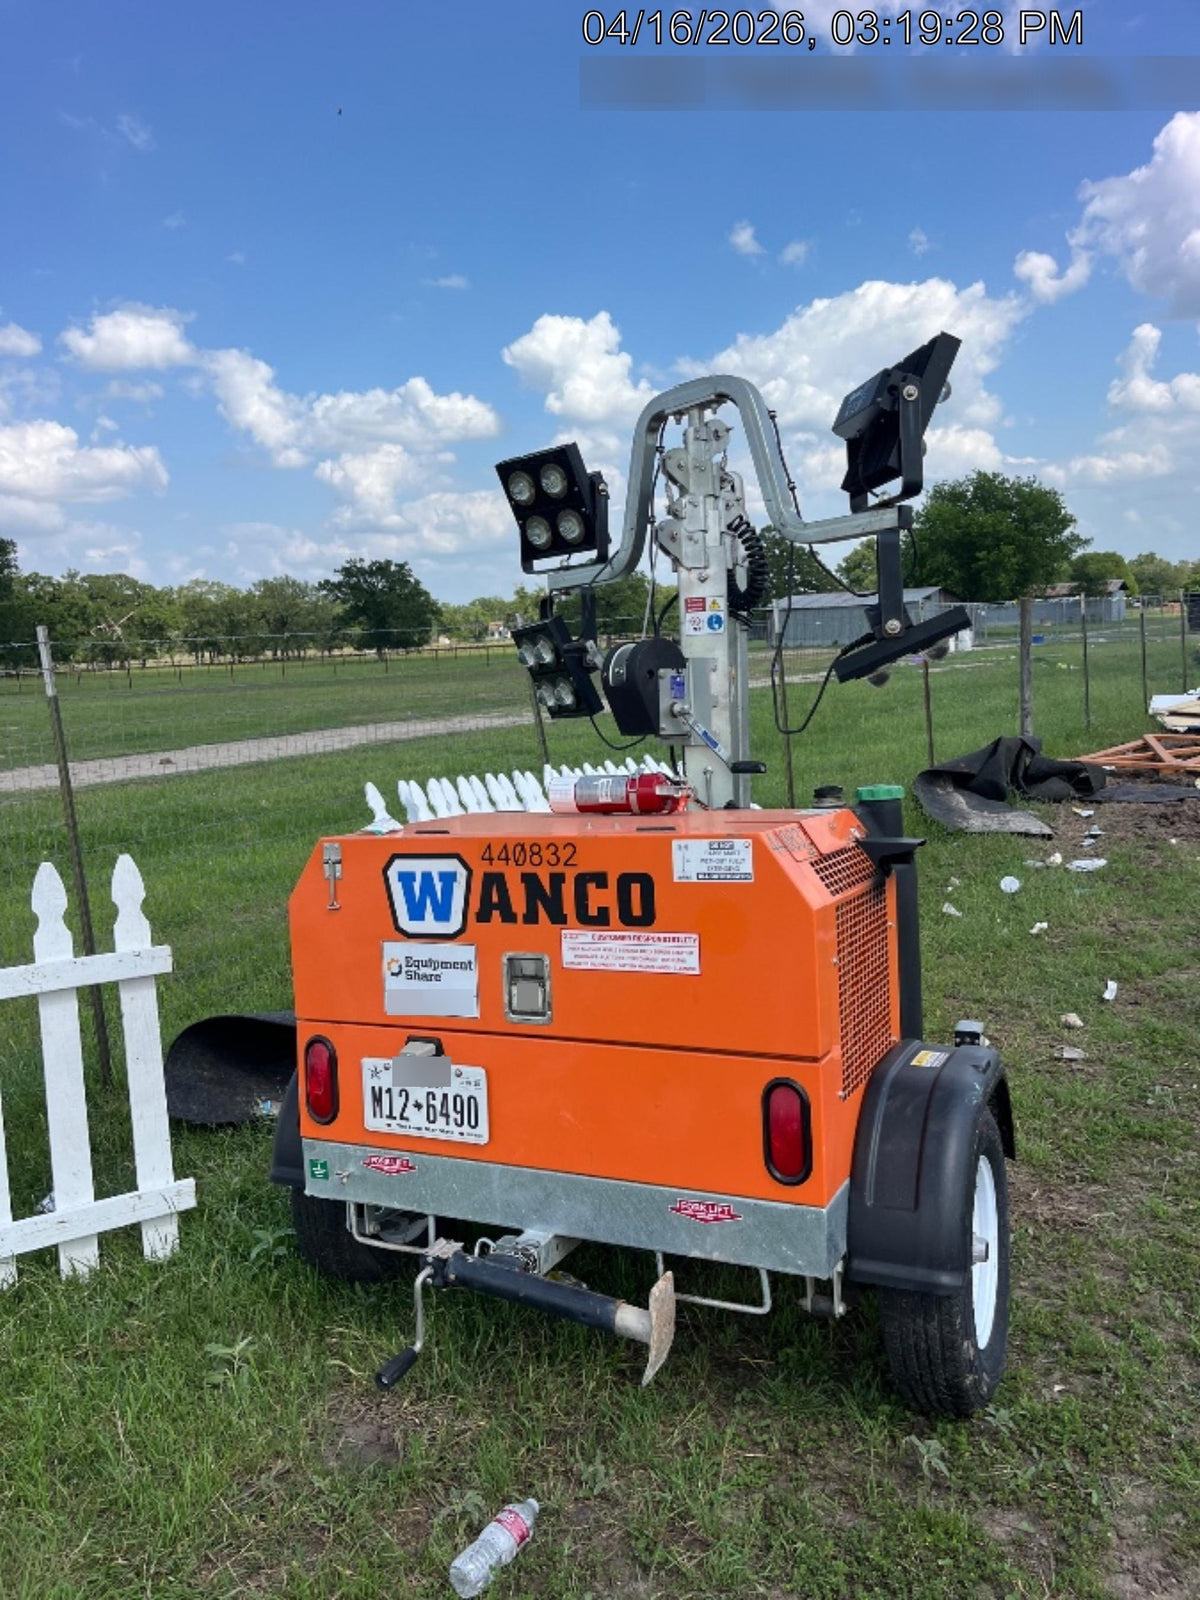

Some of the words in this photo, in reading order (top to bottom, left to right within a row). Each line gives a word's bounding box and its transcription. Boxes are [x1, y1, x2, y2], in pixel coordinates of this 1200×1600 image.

[480, 842, 578, 868] 440832
[397, 870, 656, 927] WANCO
[404, 955, 474, 971] Equipment
[404, 970, 442, 982] Share
